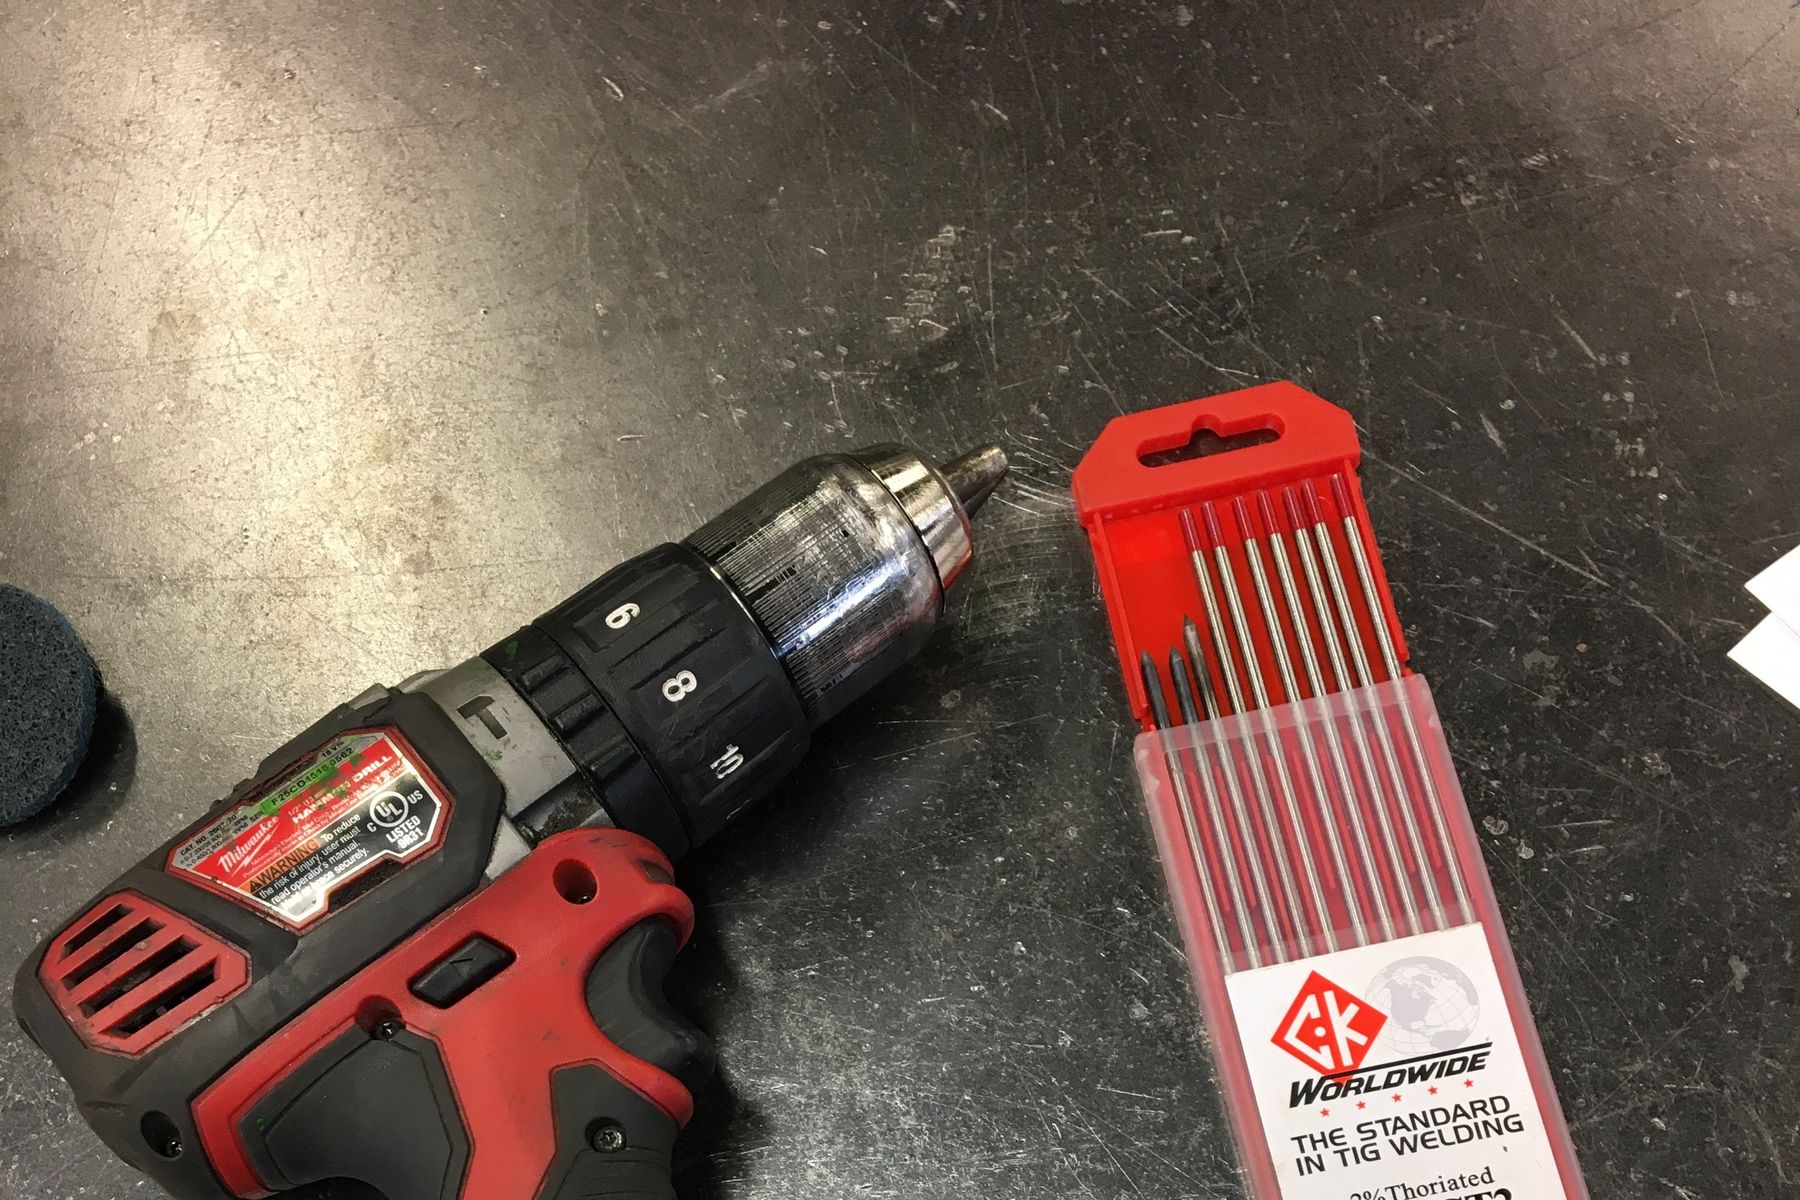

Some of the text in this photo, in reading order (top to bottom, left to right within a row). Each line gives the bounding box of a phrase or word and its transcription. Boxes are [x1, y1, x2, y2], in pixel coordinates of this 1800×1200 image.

[605, 602, 640, 629] 6
[661, 670, 698, 702] 8
[352, 755, 392, 783] DRILL
[409, 789, 424, 805] US
[218, 816, 280, 872] Milwaukee
[257, 839, 319, 885] WARNING
[320, 831, 333, 843] To
[333, 814, 361, 835] reduce
[385, 815, 421, 843] LISTED
[259, 886, 274, 899] the
[274, 875, 290, 891] risk
[290, 868, 298, 879] of
[321, 840, 340, 856] user
[340, 826, 362, 847] must
[271, 887, 291, 904] read
[329, 842, 361, 866] manual.
[334, 847, 370, 875] securely.
[1289, 1050, 1491, 1109] WORLDWIDE
[1290, 1095, 1511, 1155] THE STANDARD
[1296, 1113, 1525, 1177] IN TIG WELDING
